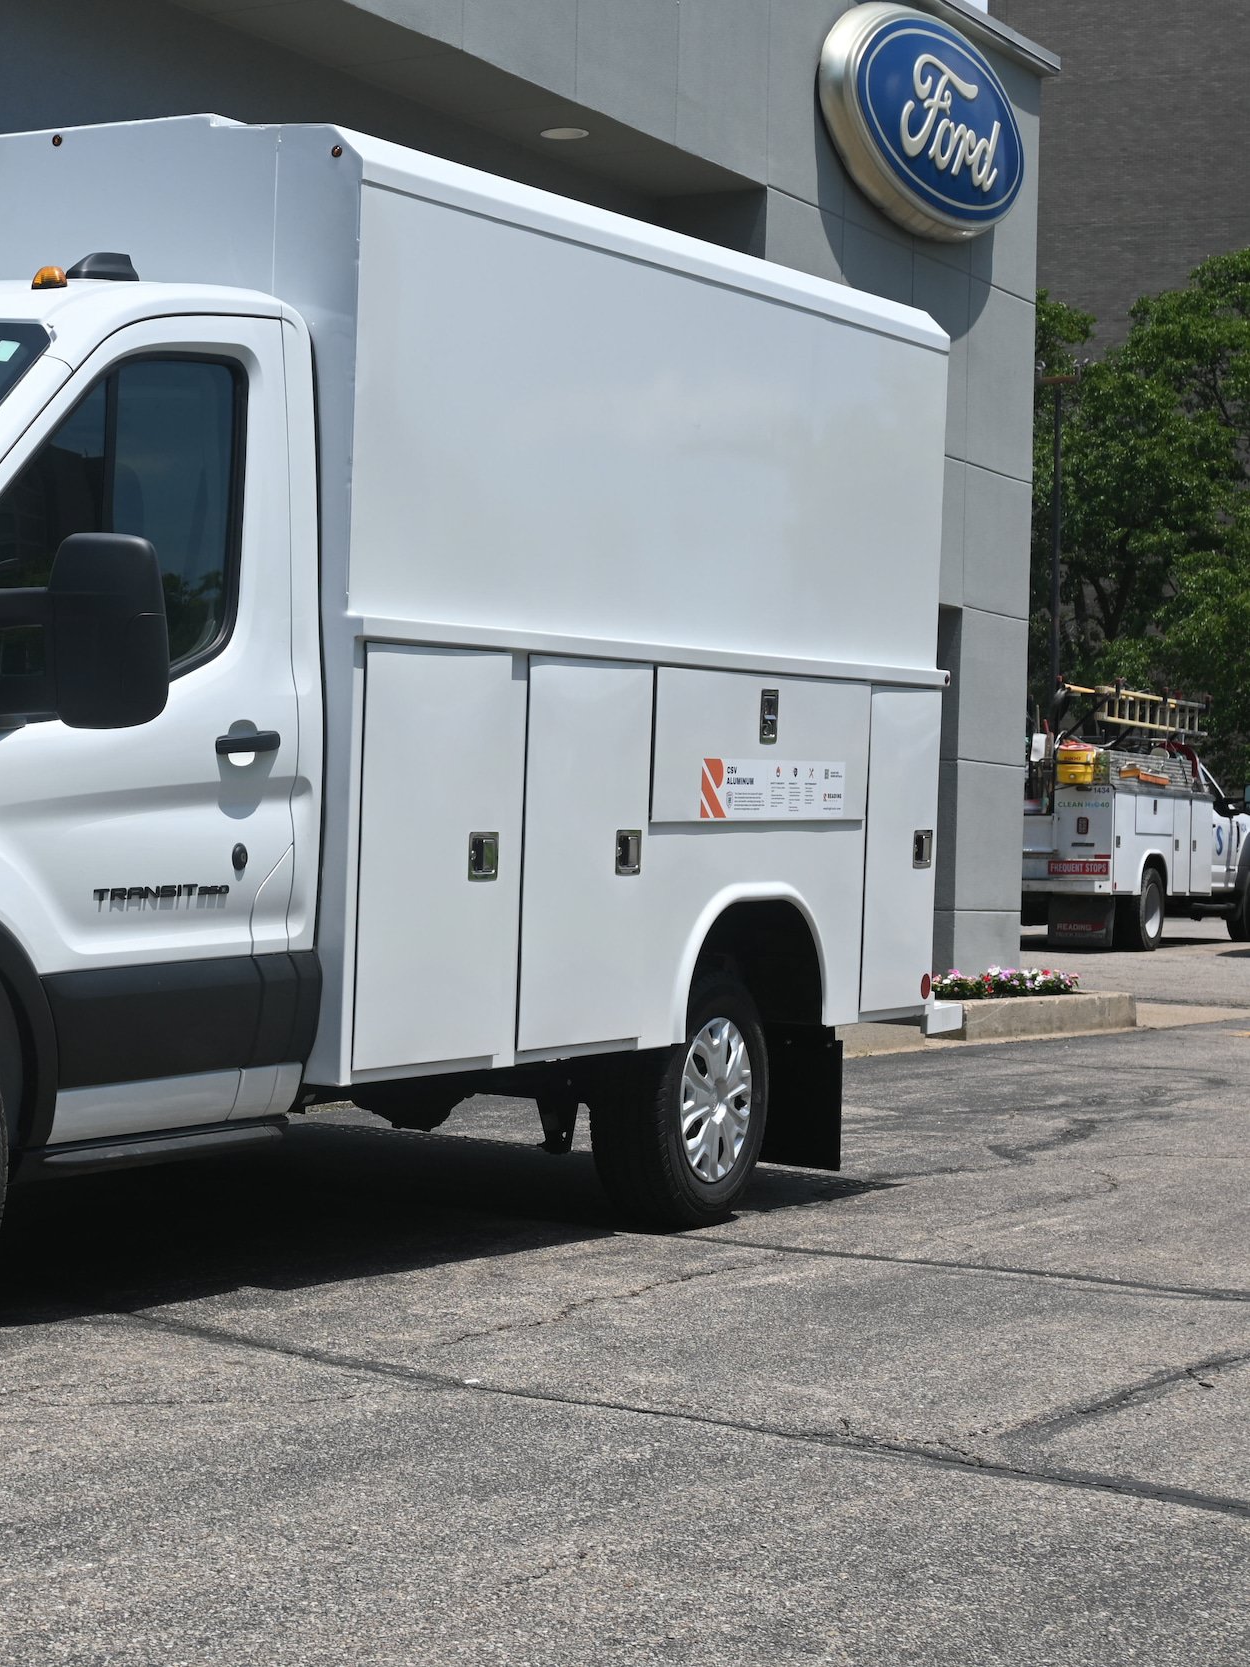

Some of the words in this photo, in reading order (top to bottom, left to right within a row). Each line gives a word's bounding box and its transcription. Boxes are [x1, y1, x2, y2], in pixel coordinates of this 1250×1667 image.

[901, 53, 1001, 192] Ford
[726, 766, 738, 774] CSV
[726, 777, 755, 785] ALUMINUM
[1050, 863, 1083, 873] FREQUENT
[1085, 863, 1107, 873] STOPS
[93, 884, 199, 902] TRANSIT
[1056, 922, 1092, 932] READING
